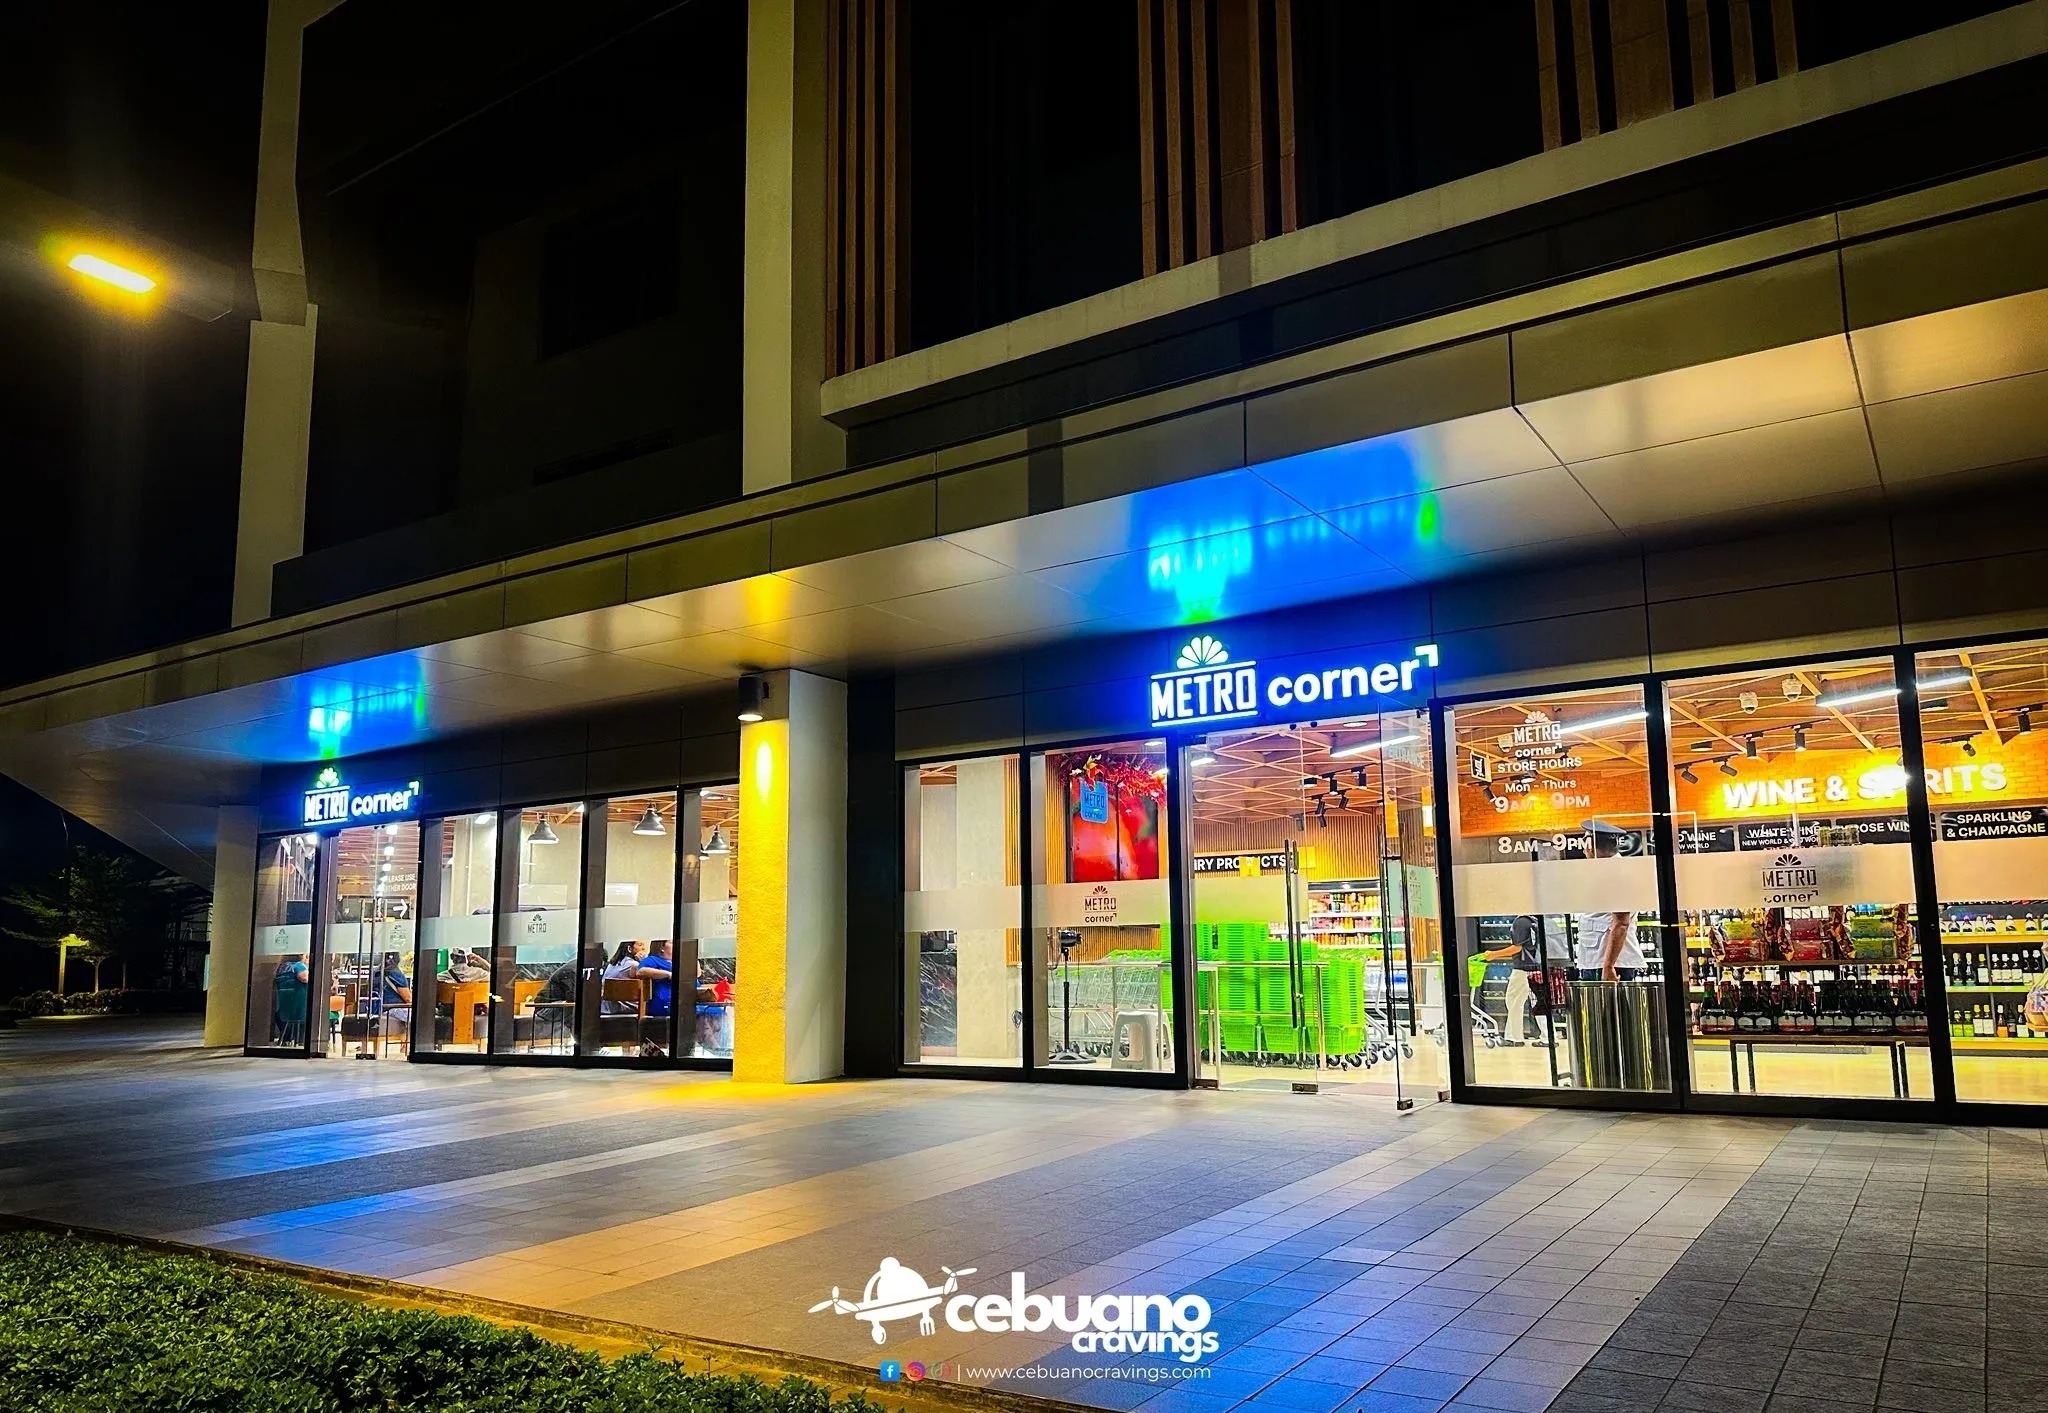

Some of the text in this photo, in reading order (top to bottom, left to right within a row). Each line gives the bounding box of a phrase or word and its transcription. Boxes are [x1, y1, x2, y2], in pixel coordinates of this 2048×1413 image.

[1151, 658, 1420, 720] METRO corner
[1513, 724, 1560, 743] METRO
[1515, 746, 1557, 757] corner
[1498, 760, 1537, 773] STORE
[1540, 756, 1583, 769] HOURS
[1505, 782, 1531, 793] Mon
[1542, 780, 1577, 790] Thurs
[1723, 778, 1816, 809] WINE
[1825, 776, 1849, 802] &
[305, 789, 412, 821] METRO corner
[1957, 811, 2032, 824] SPARKLING
[1748, 828, 1787, 839] WHITE
[1859, 821, 1910, 833] OSE WIN
[1946, 823, 2046, 838] & CHAMPAGNE
[1216, 855, 1287, 870] PROCTS
[388, 874, 405, 882] LEASE
[1085, 898, 1117, 911] METRO
[1085, 915, 1114, 923] corner
[528, 923, 547, 933] METRO
